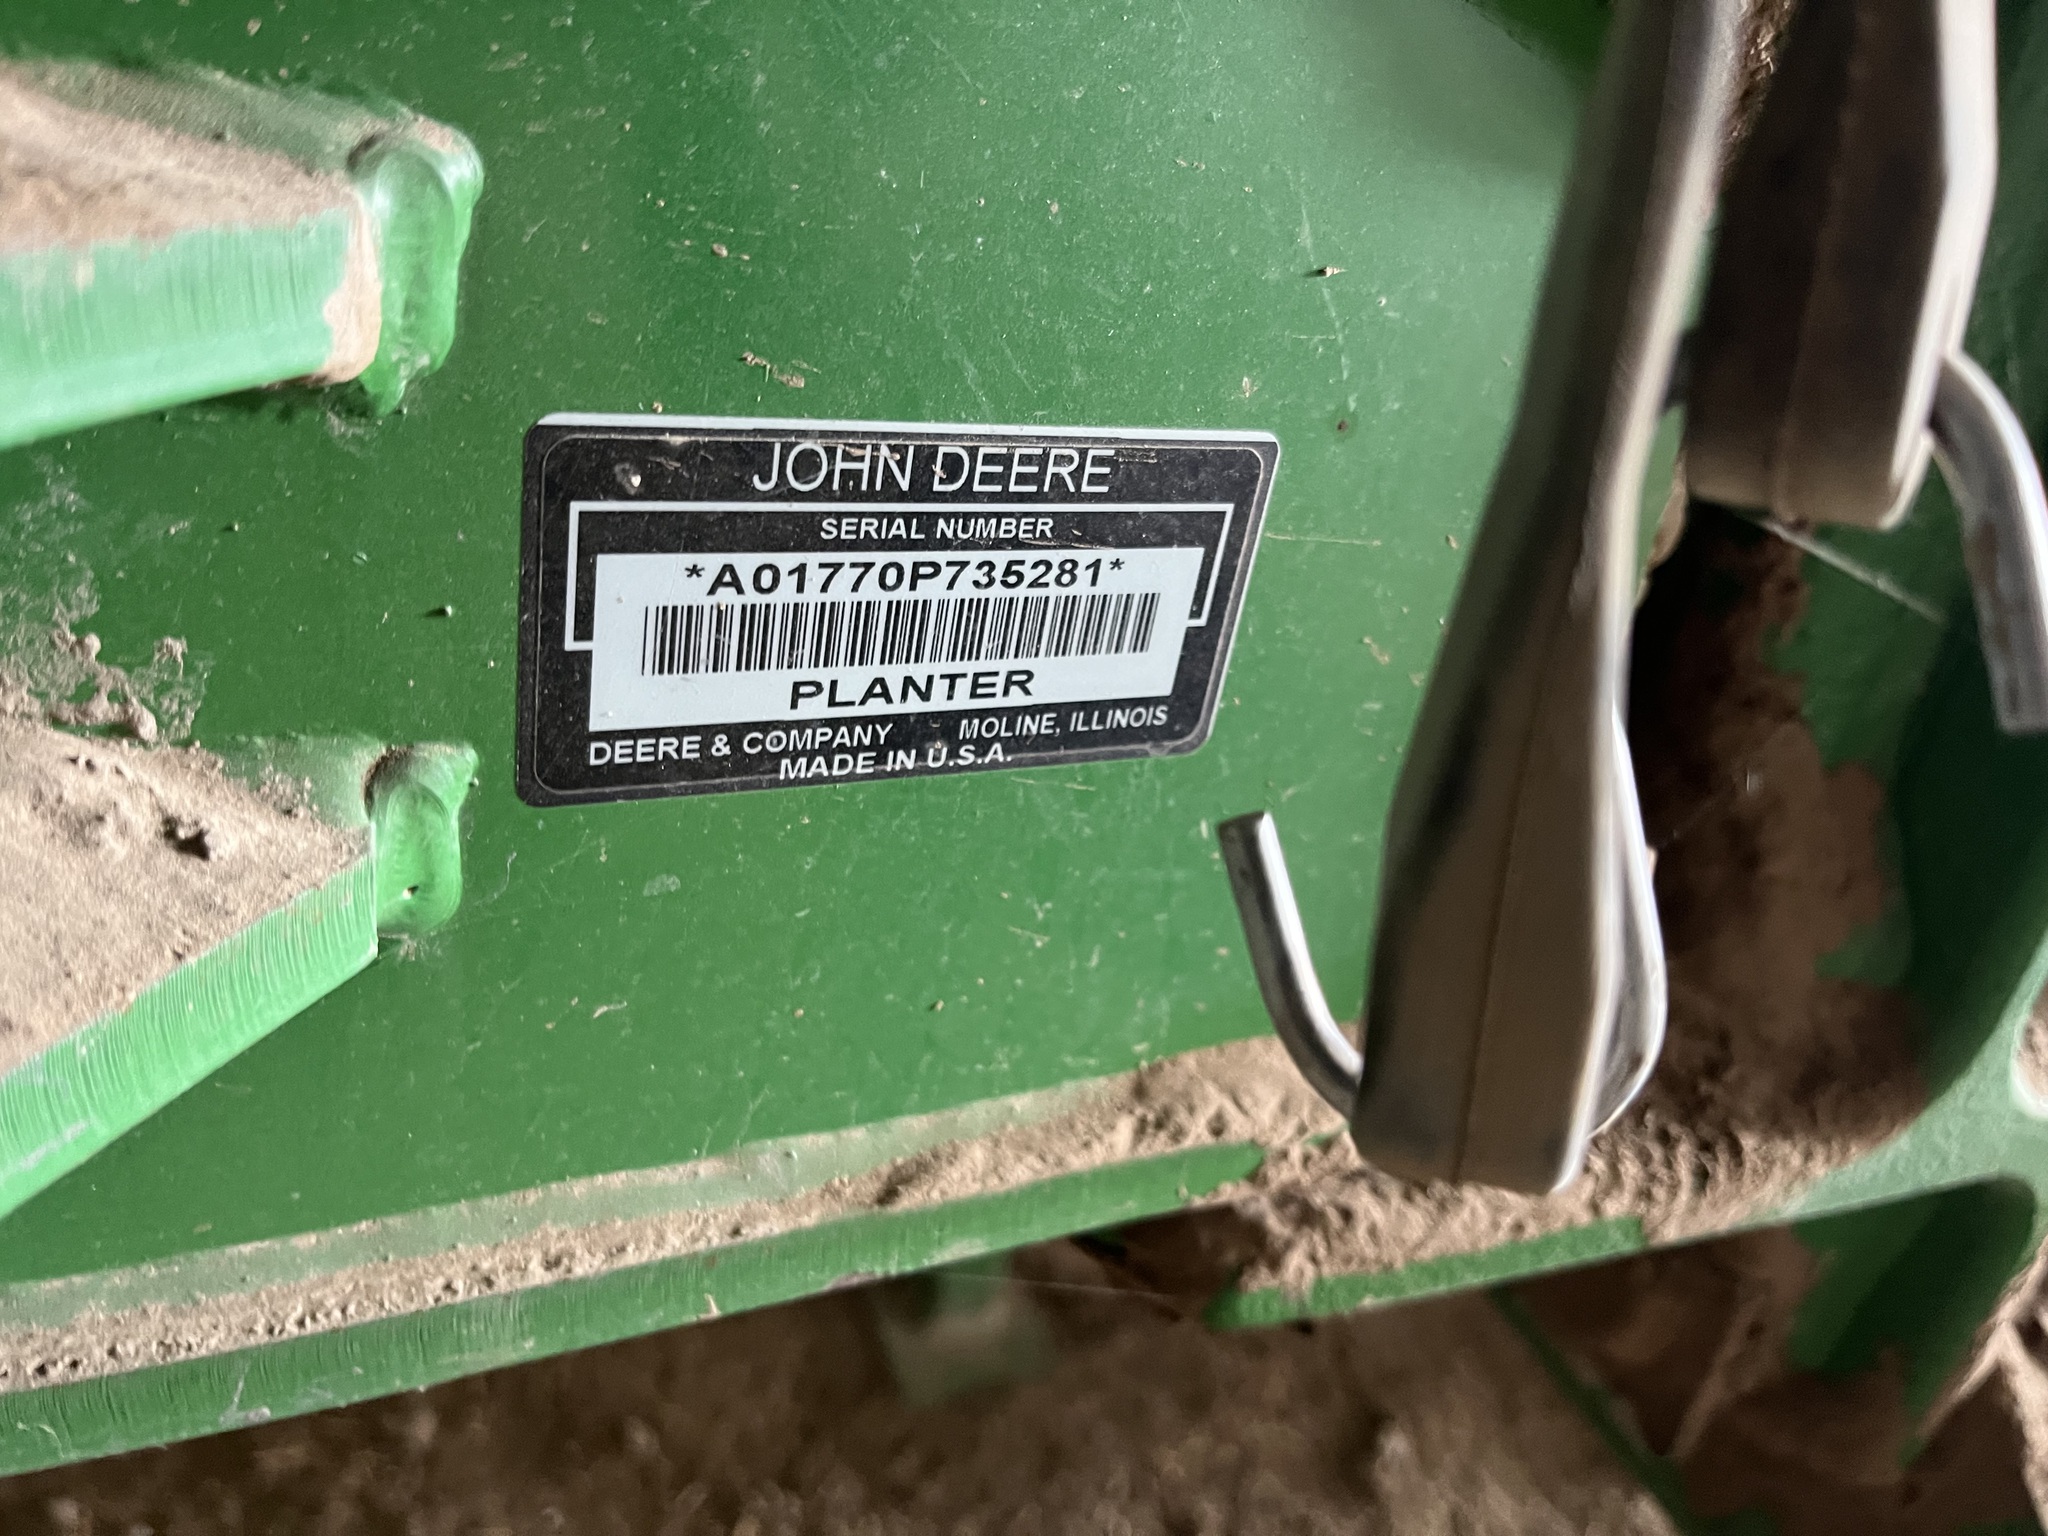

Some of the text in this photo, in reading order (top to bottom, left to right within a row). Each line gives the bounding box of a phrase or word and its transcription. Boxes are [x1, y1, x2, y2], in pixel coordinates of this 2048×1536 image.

[752, 442, 1116, 494] JOHN DEERE
[820, 517, 1054, 540] SERIAL NUMBER
[789, 669, 1035, 710] PLANTER
[589, 705, 1169, 765] DEERE & COMPANY MOLINE, ILLINOIS
[779, 743, 1013, 781] MADE IN U.S.A.
